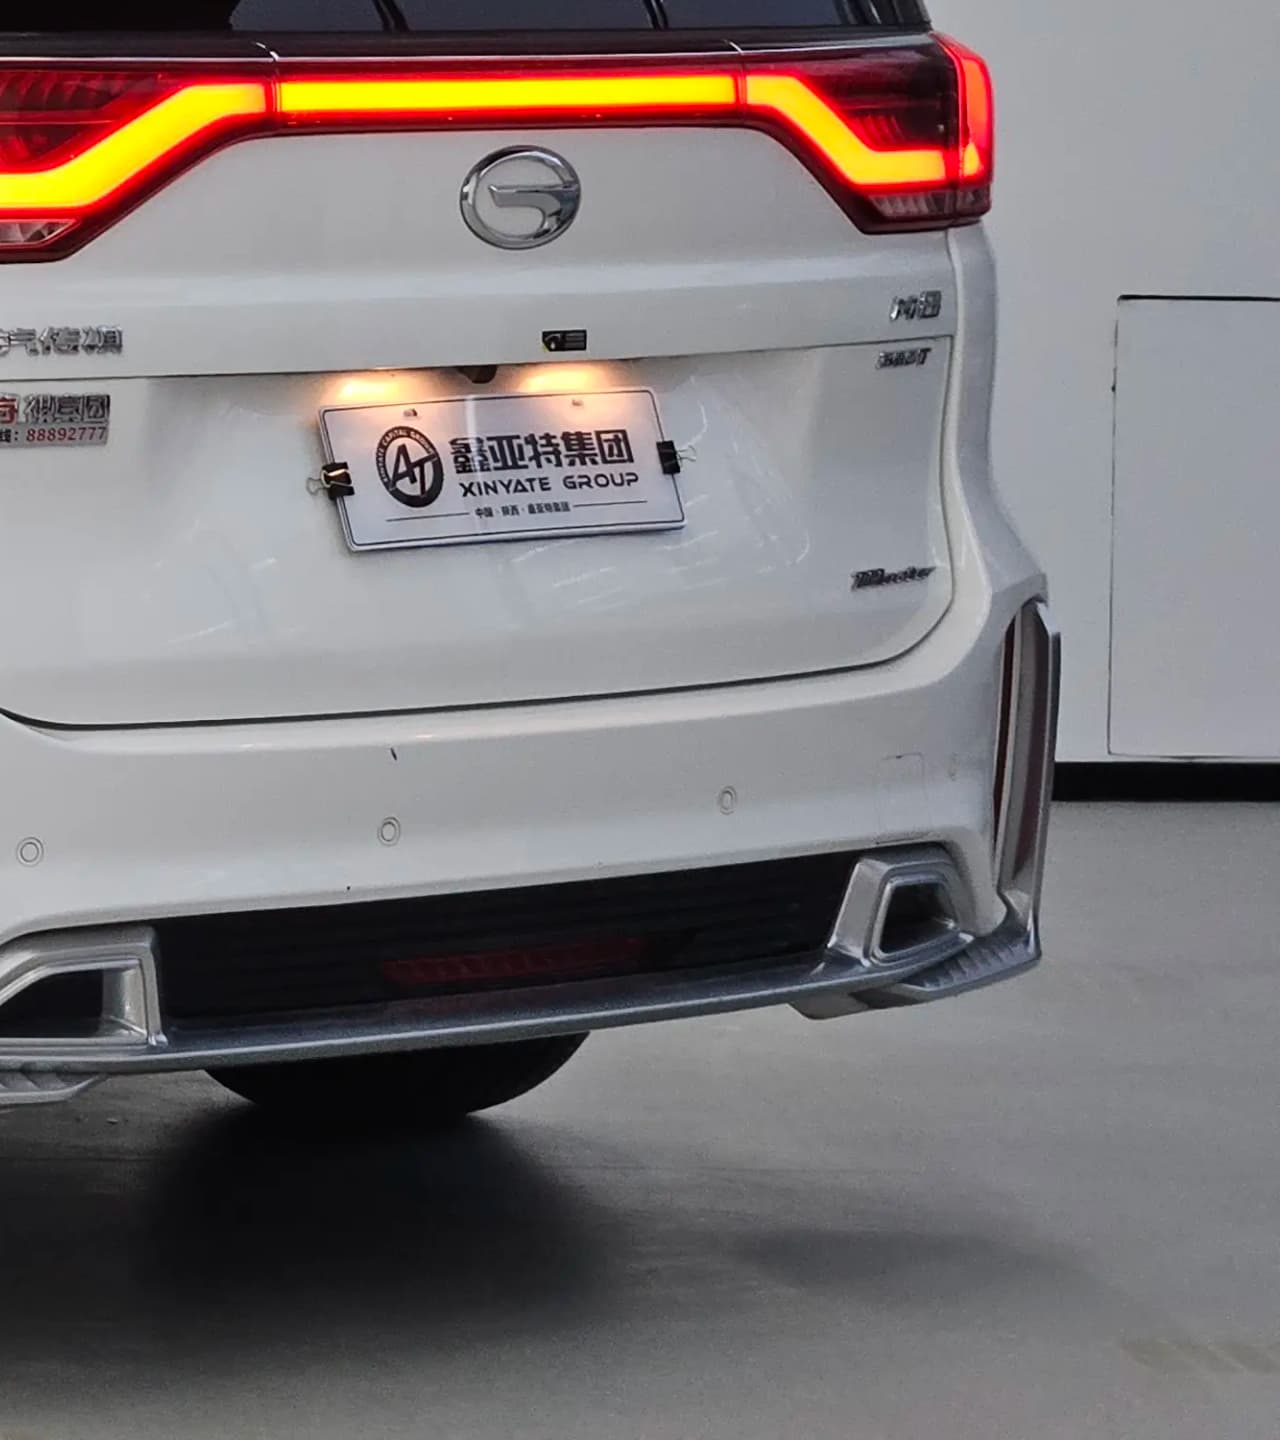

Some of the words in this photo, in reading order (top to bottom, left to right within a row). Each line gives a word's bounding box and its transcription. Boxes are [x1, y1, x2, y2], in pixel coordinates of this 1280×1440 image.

[448, 428, 636, 475] 鑫亚特集团
[458, 476, 553, 498] XINYATE
[562, 471, 640, 491] GROUP
